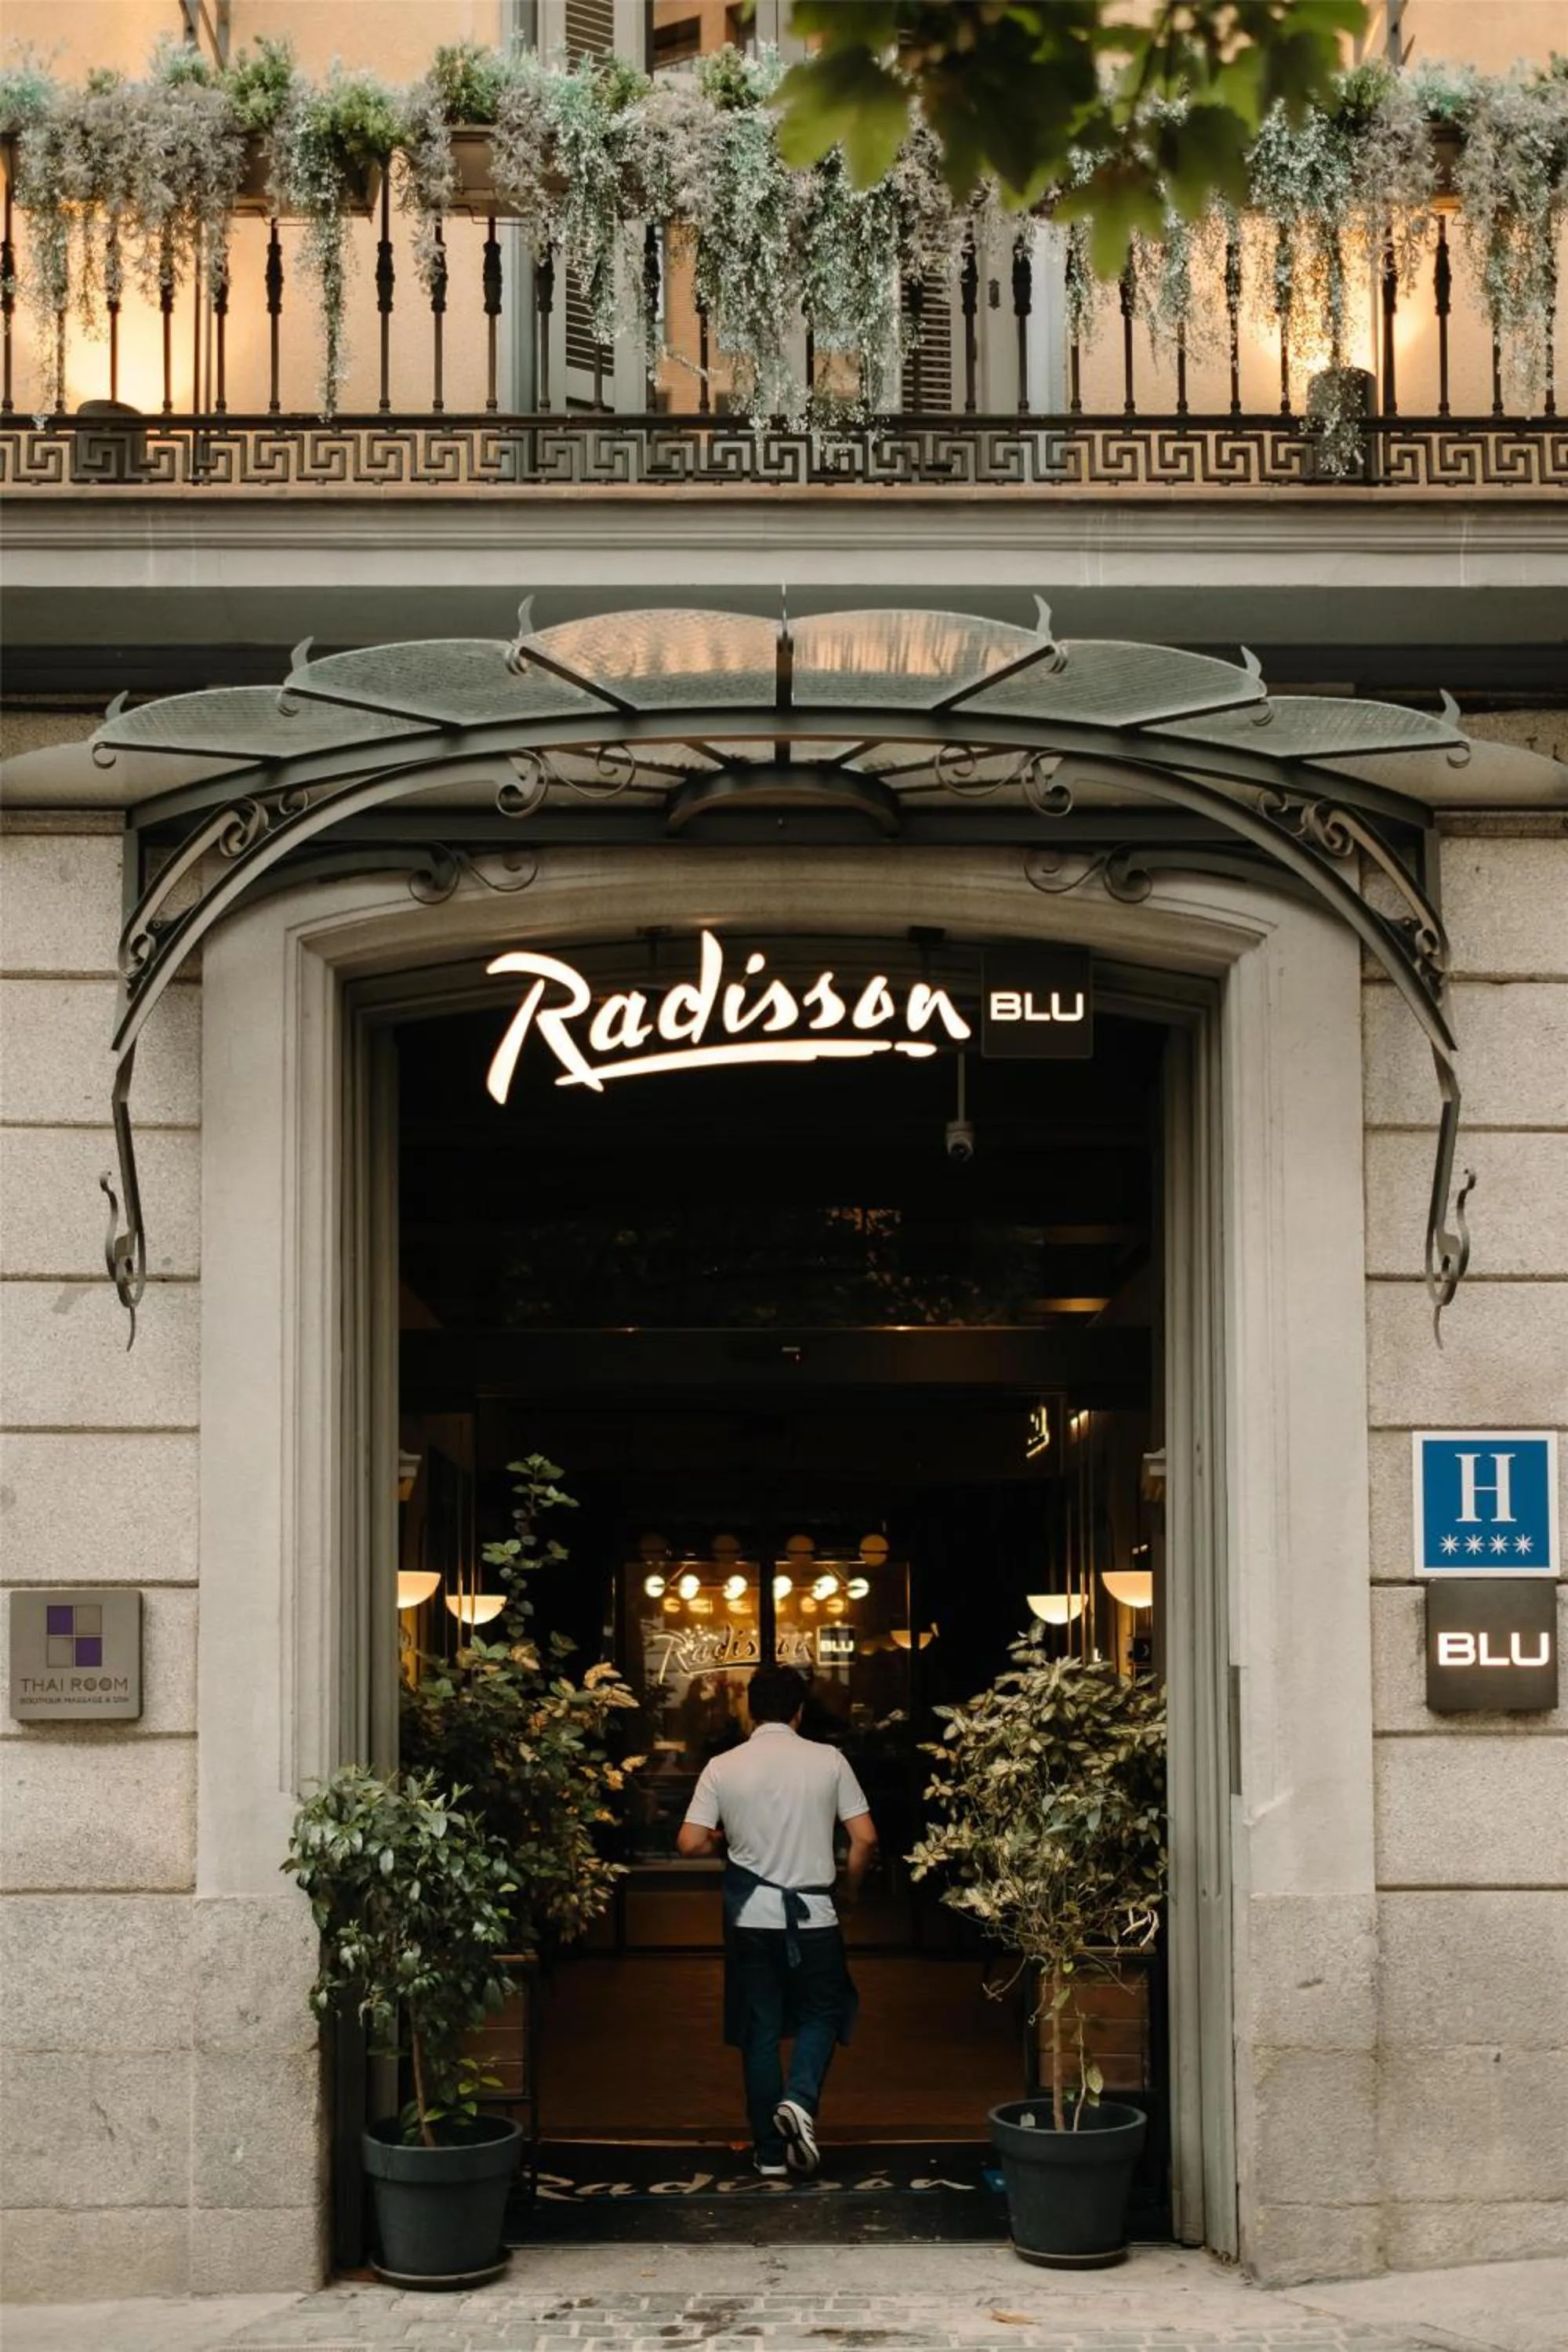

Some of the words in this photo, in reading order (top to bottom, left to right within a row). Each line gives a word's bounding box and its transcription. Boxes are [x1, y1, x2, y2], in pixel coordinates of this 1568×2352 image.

[486, 929, 972, 1105] Radisson
[989, 991, 1085, 1022] BLU
[1454, 1454, 1517, 1523] H
[652, 1621, 813, 1684] Radison
[1437, 1632, 1550, 1666] BLU
[20, 1678, 64, 1693] THAI
[71, 1677, 128, 1692] ROOM
